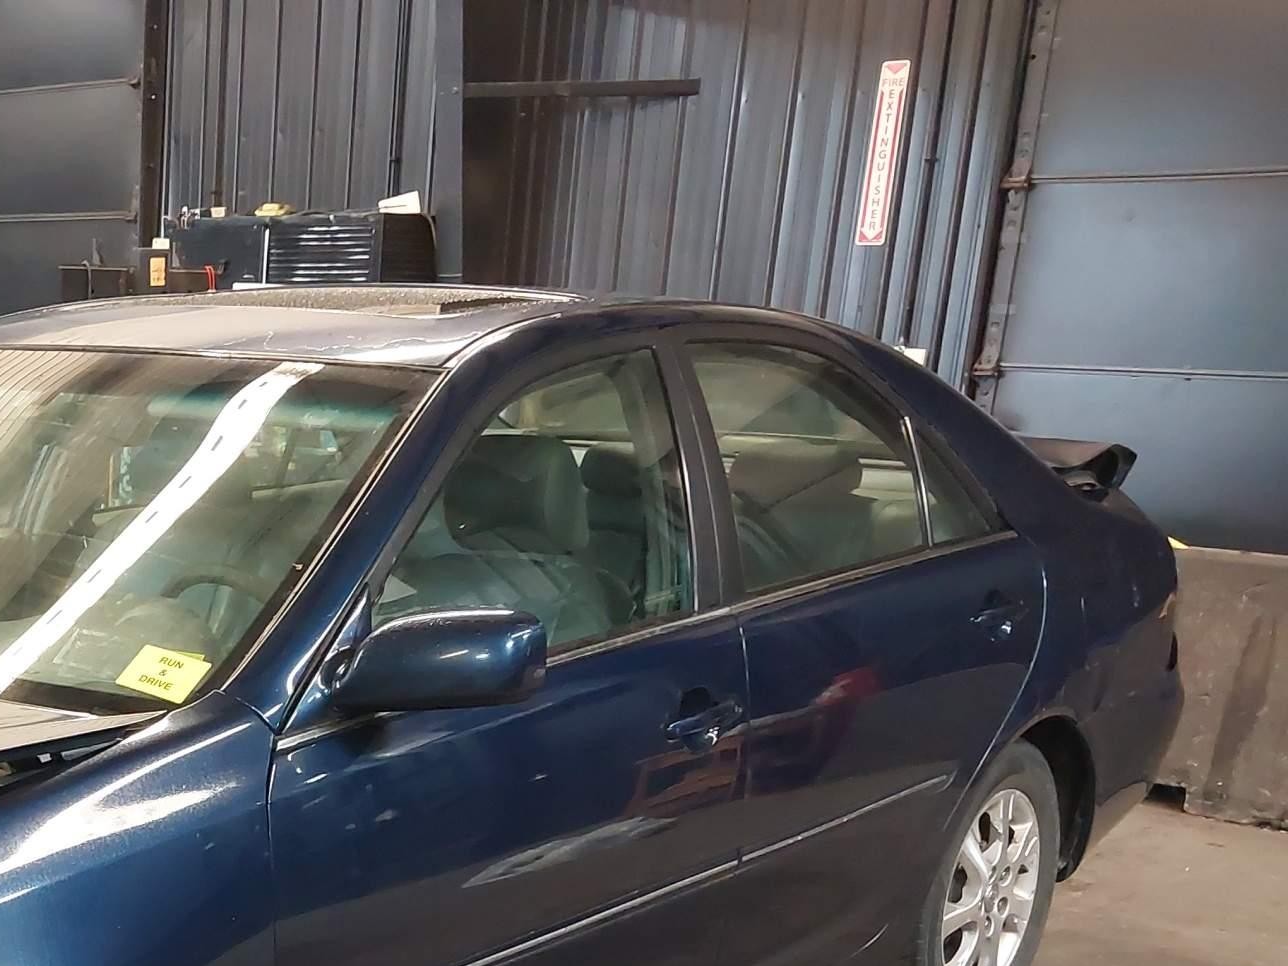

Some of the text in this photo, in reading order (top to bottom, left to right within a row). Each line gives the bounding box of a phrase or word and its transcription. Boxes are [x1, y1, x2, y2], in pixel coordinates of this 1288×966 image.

[881, 79, 905, 87] FIRE
[868, 89, 896, 231] EXTINGUISHER
[158, 656, 184, 669] RUN
[158, 669, 169, 677] &
[138, 674, 174, 691] DRIVE
